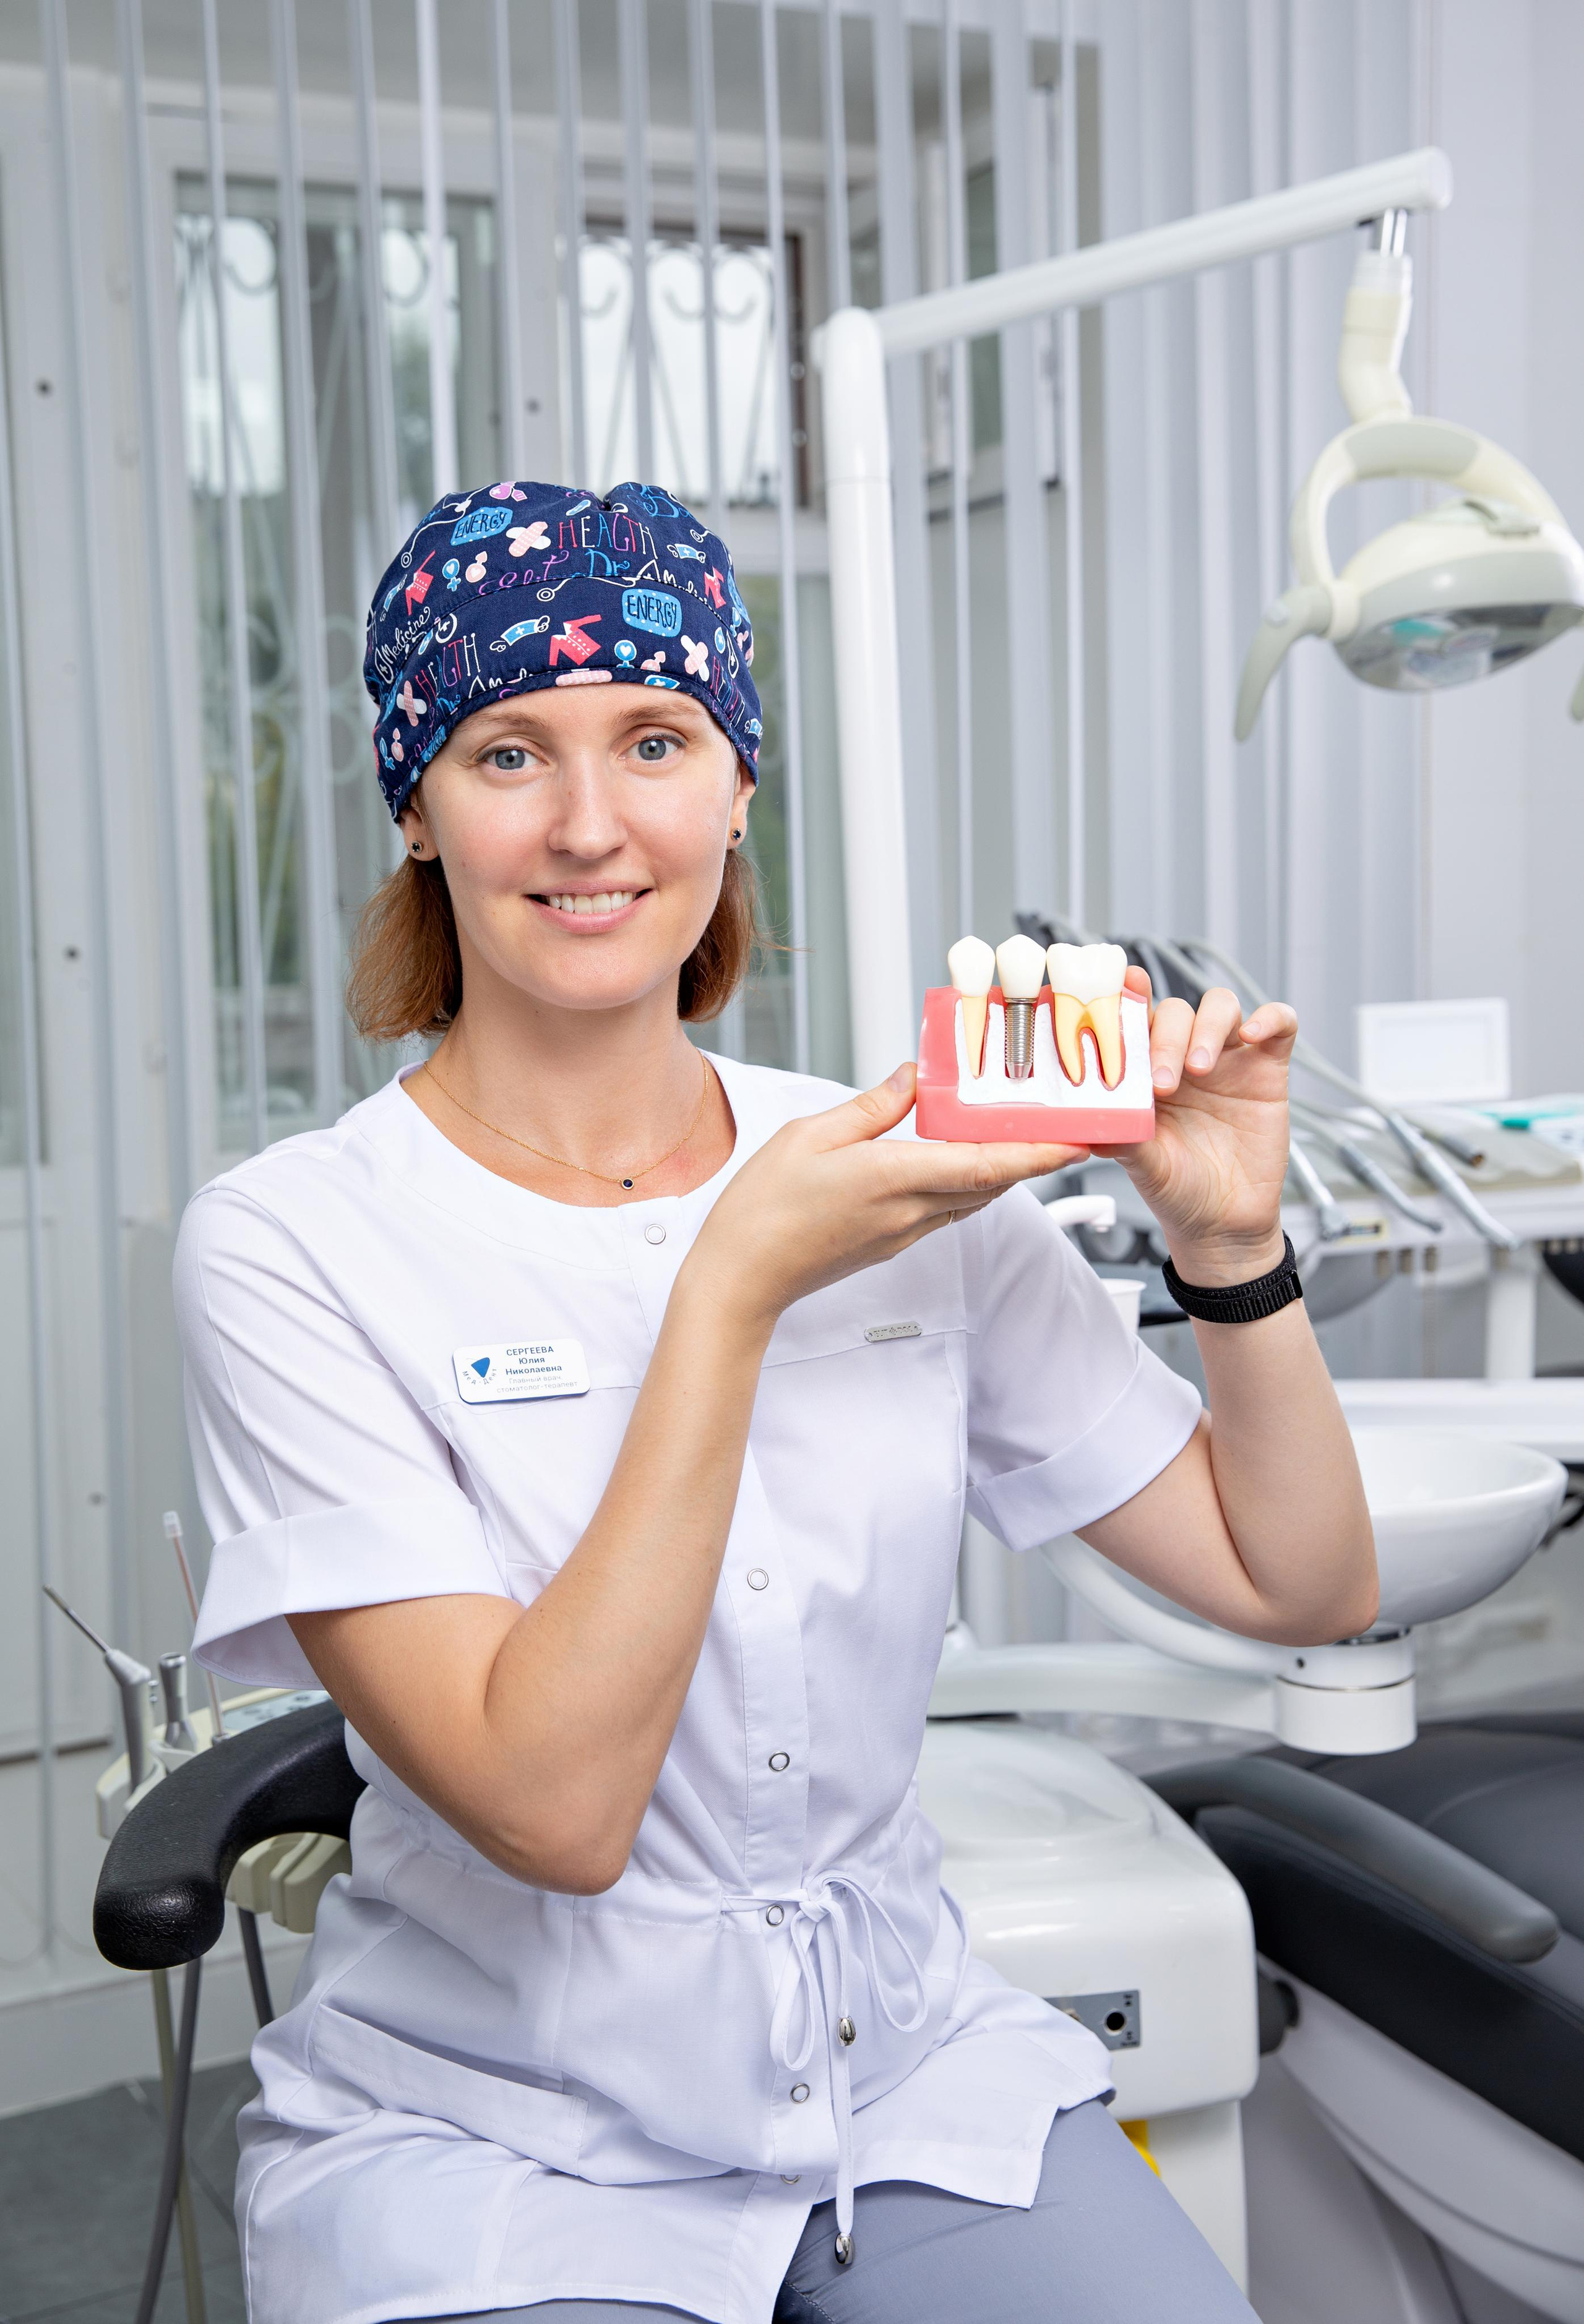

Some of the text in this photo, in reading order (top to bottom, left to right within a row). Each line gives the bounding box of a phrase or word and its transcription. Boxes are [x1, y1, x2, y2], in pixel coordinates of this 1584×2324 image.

[455, 512, 507, 539] ENERGY
[559, 513, 658, 559] HEALTH
[627, 594, 677, 629] ENERGY
[381, 606, 431, 666] Medicine
[506, 1345, 554, 1356] СЕРГЕЕВА
[519, 1357, 545, 1365] Юлия
[506, 1365, 562, 1375] Николаевна
[509, 1376, 541, 1384] Главный
[497, 1381, 578, 1394] стоматолог-терапевт
